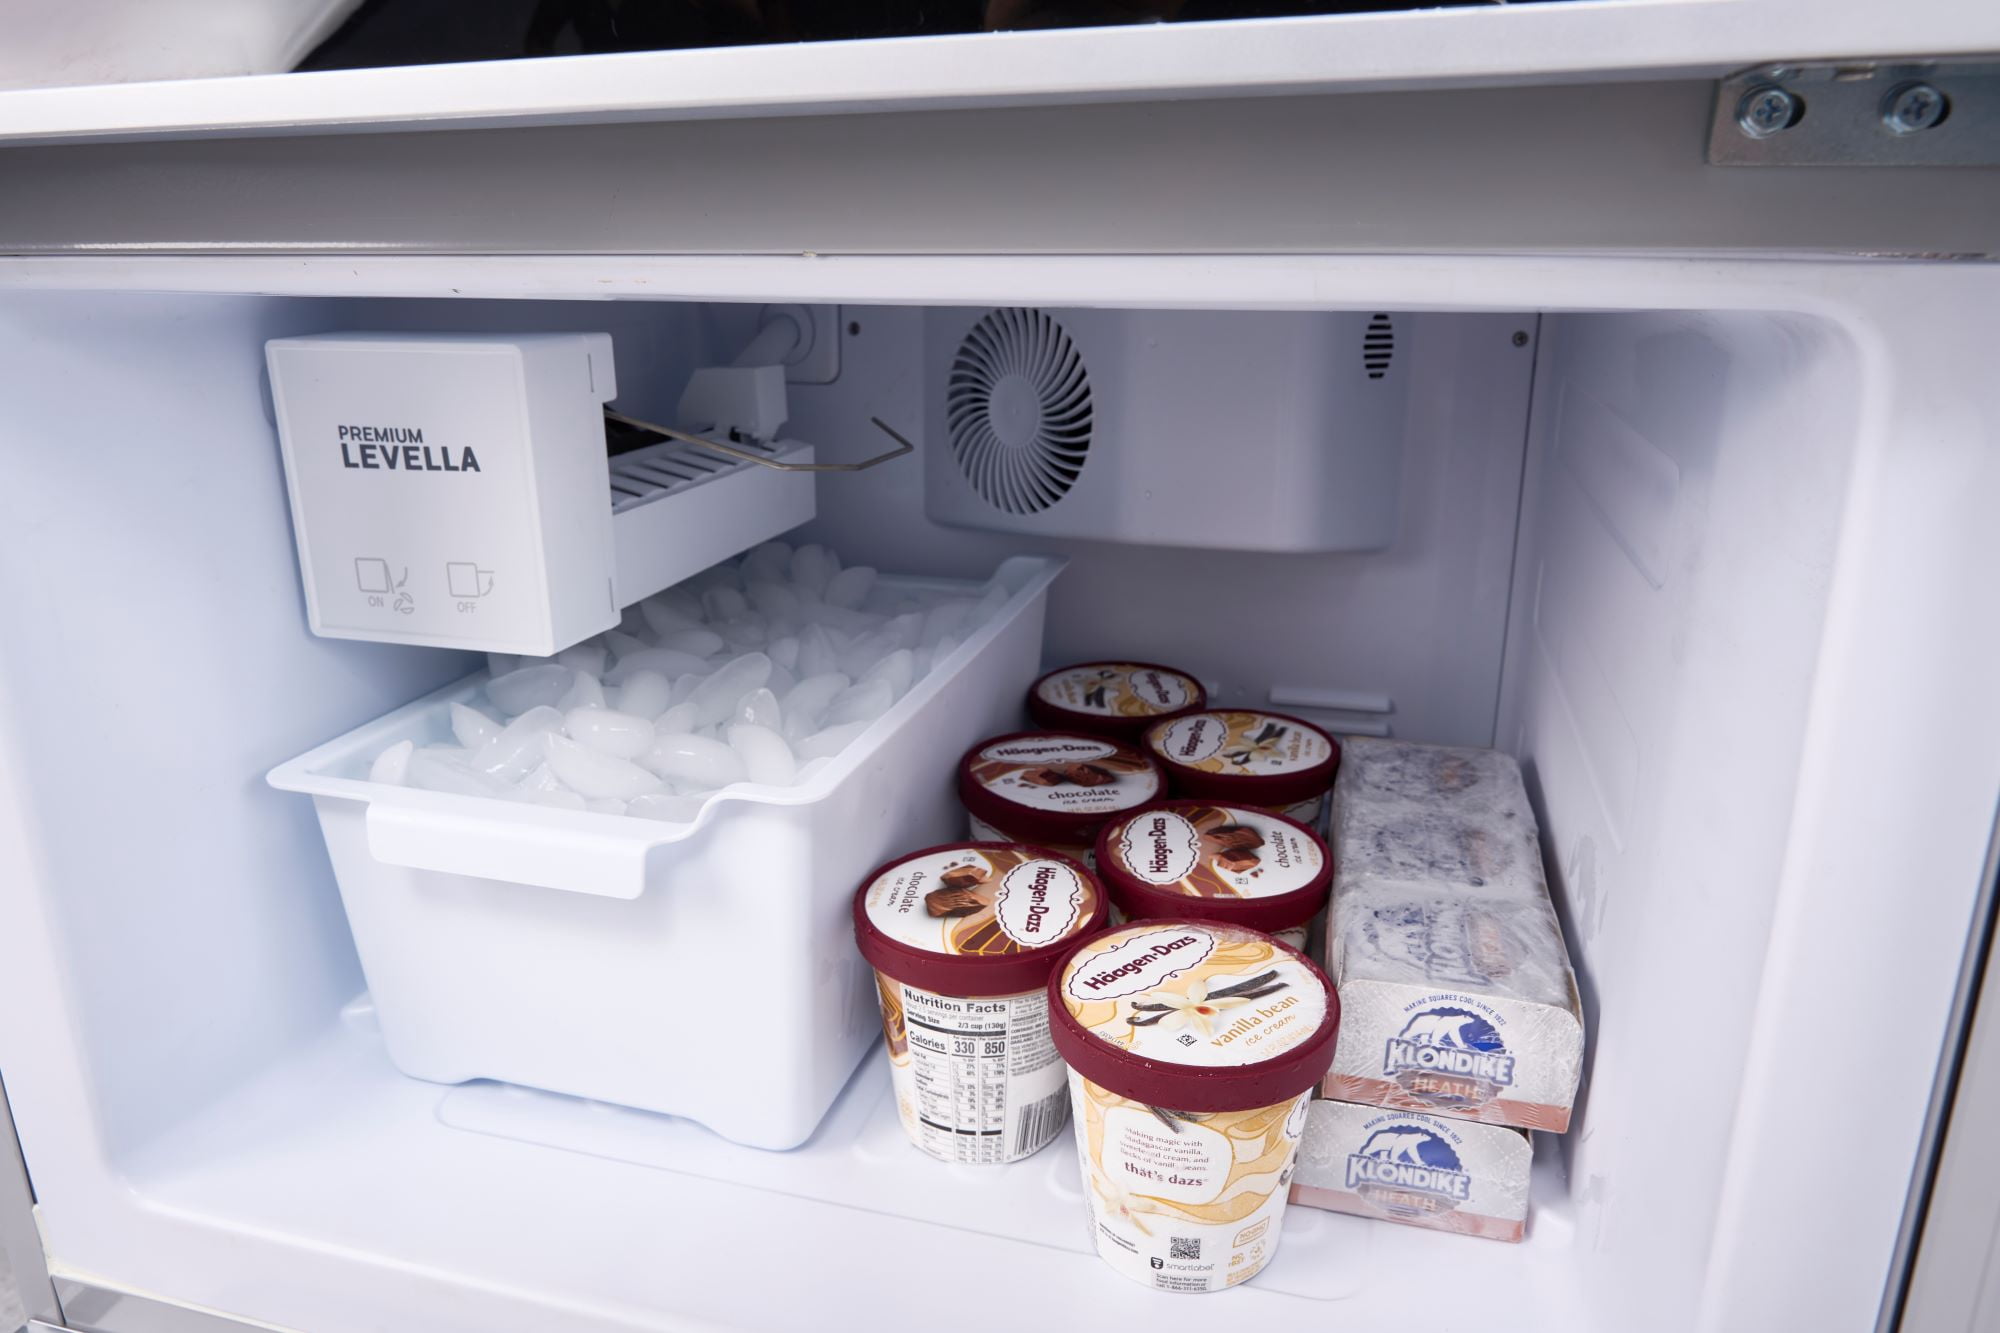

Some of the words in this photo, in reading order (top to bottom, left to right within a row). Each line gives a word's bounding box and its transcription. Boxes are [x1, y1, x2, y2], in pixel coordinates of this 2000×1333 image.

[338, 425, 423, 443] PREMIUM
[340, 443, 481, 472] LEVELLA
[368, 595, 384, 607] ON
[457, 601, 477, 614] OFF
[1048, 788, 1121, 801] chocolate
[1148, 817, 1173, 873] Häagen-Dazs
[1270, 830, 1290, 868] chocolate
[899, 871, 927, 913] chocolate
[1025, 866, 1057, 933] Häagen-Dazs
[1083, 934, 1197, 991] Häagen-Dazs
[904, 988, 961, 1012] Nutrition
[966, 1003, 1006, 1013] Facts
[1404, 998, 1428, 1012] MAKING
[1428, 994, 1458, 1002] SQUARES
[1459, 996, 1475, 1006] COOL
[1476, 1002, 1496, 1016] SINCE
[1494, 1013, 1507, 1027] 1922
[907, 1009, 927, 1021] Serving
[928, 1016, 940, 1024] Size
[984, 1022, 1006, 1030] (130g)
[1210, 1016, 1263, 1048] vanilla
[1256, 995, 1299, 1019] bean
[1245, 1033, 1263, 1047] ice
[1263, 1013, 1296, 1035] cream
[909, 1030, 946, 1051] Calories
[954, 1040, 975, 1054] 330
[984, 1040, 1005, 1055] 850
[1384, 1038, 1515, 1086] KLONDIKE
[1413, 1077, 1480, 1100] HEATH
[1363, 1116, 1386, 1130] MAKING
[1387, 1112, 1415, 1121] SQUARES
[1416, 1114, 1431, 1124] COOL
[1433, 1120, 1452, 1134] SINCE
[1125, 1134, 1171, 1152] Madagascar
[1174, 1148, 1203, 1156] vanilla,
[1126, 1127, 1154, 1142] Making
[1155, 1136, 1181, 1147] magic
[1154, 1160, 1179, 1169] vanill
[1163, 1155, 1191, 1163] cream,
[1168, 1174, 1203, 1186] dazs
[1346, 1154, 1471, 1200] KLONDIKE
[1166, 1263, 1213, 1271] smartlabel
